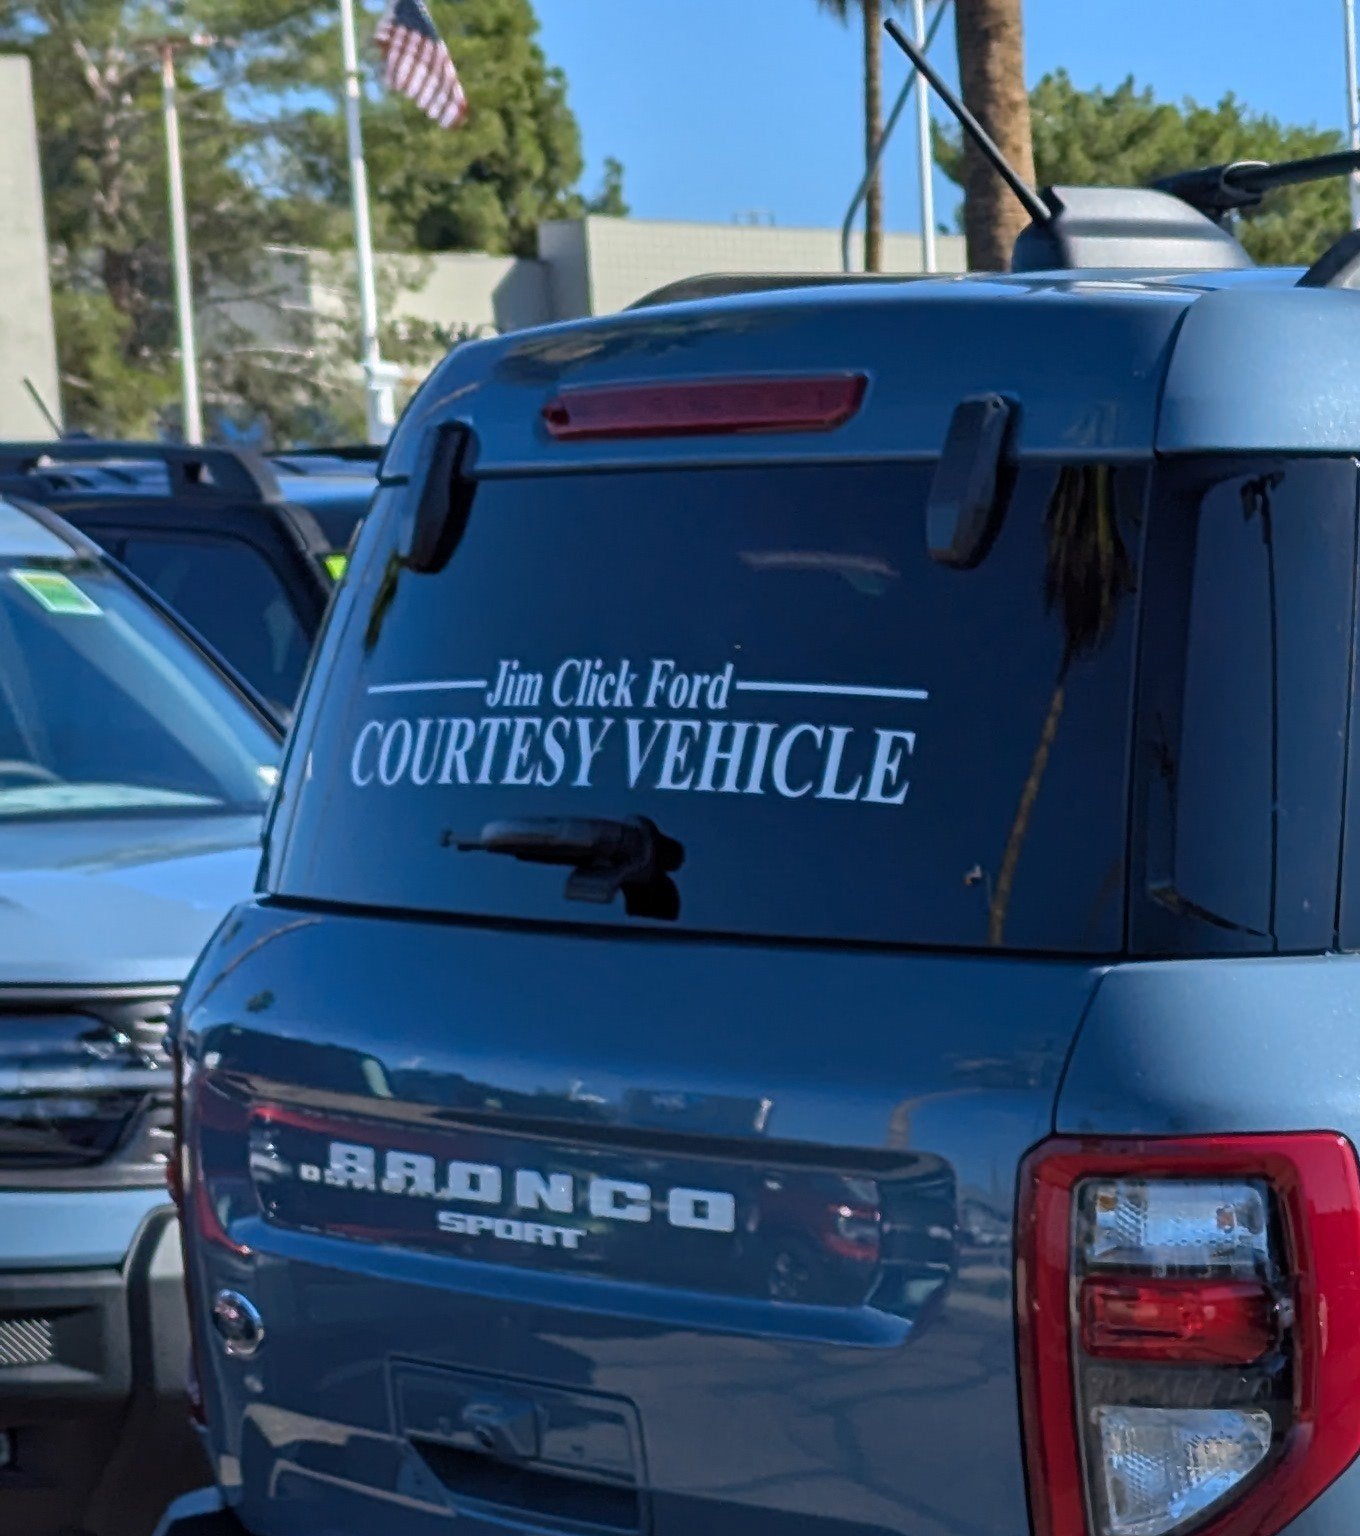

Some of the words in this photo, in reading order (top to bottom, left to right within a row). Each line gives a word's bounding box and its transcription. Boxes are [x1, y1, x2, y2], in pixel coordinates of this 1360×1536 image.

[486, 659, 544, 709] Jim
[552, 658, 637, 708] Click
[642, 660, 734, 709] Ford
[351, 717, 613, 788] COURTESY
[625, 718, 916, 805] VEHICLE
[323, 1141, 736, 1232] BRONCO
[437, 1211, 589, 1250] SPORT
